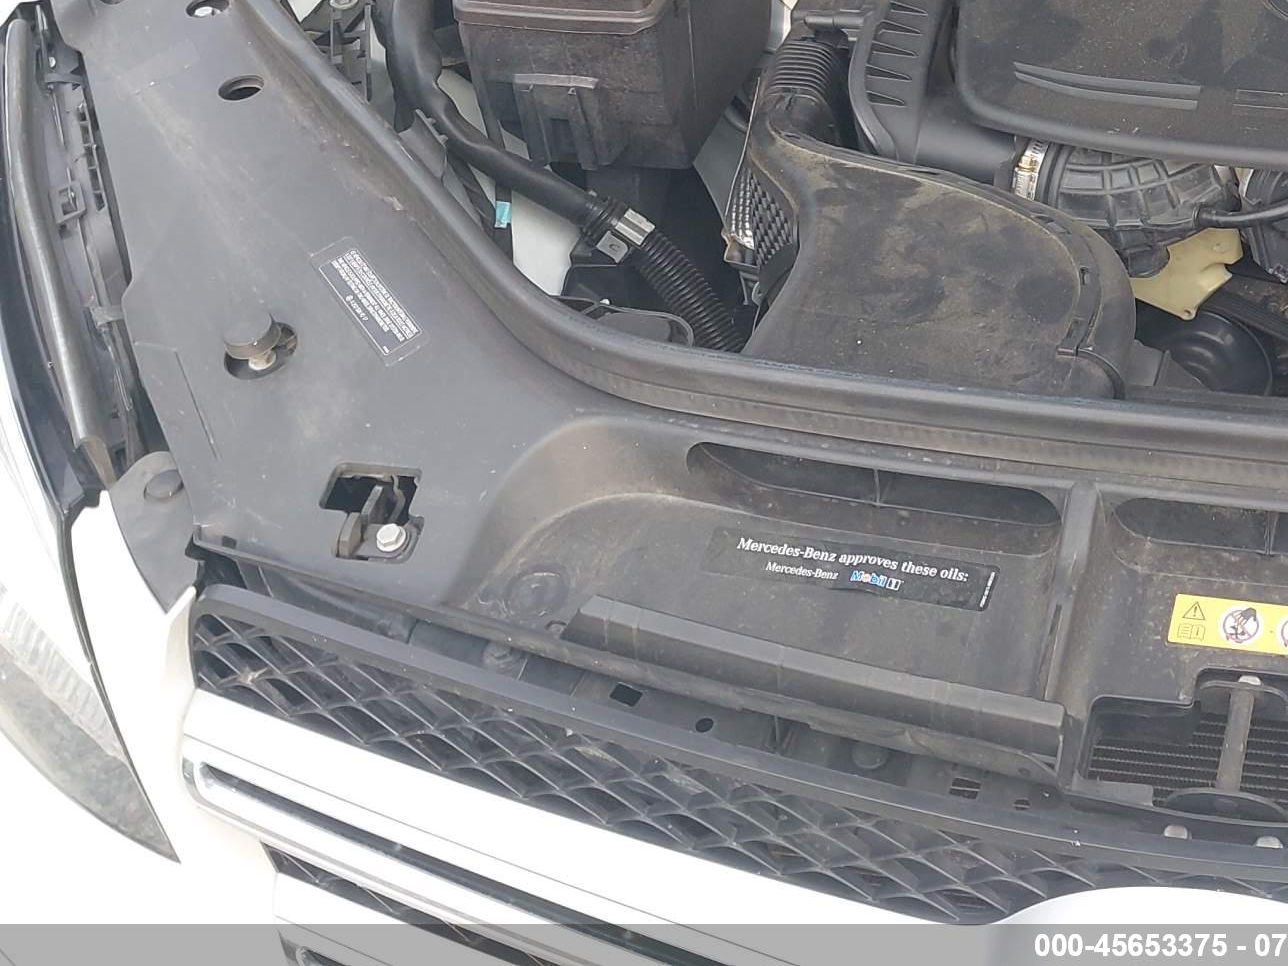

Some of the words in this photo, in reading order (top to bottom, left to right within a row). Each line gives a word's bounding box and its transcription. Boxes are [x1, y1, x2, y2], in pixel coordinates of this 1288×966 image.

[736, 537, 837, 563] Mercedes-Benz
[839, 553, 899, 570] approves
[901, 558, 937, 577] these
[940, 565, 969, 582] oils:
[765, 561, 839, 580] Mercedes-Benz
[850, 570, 887, 587] Mobil
